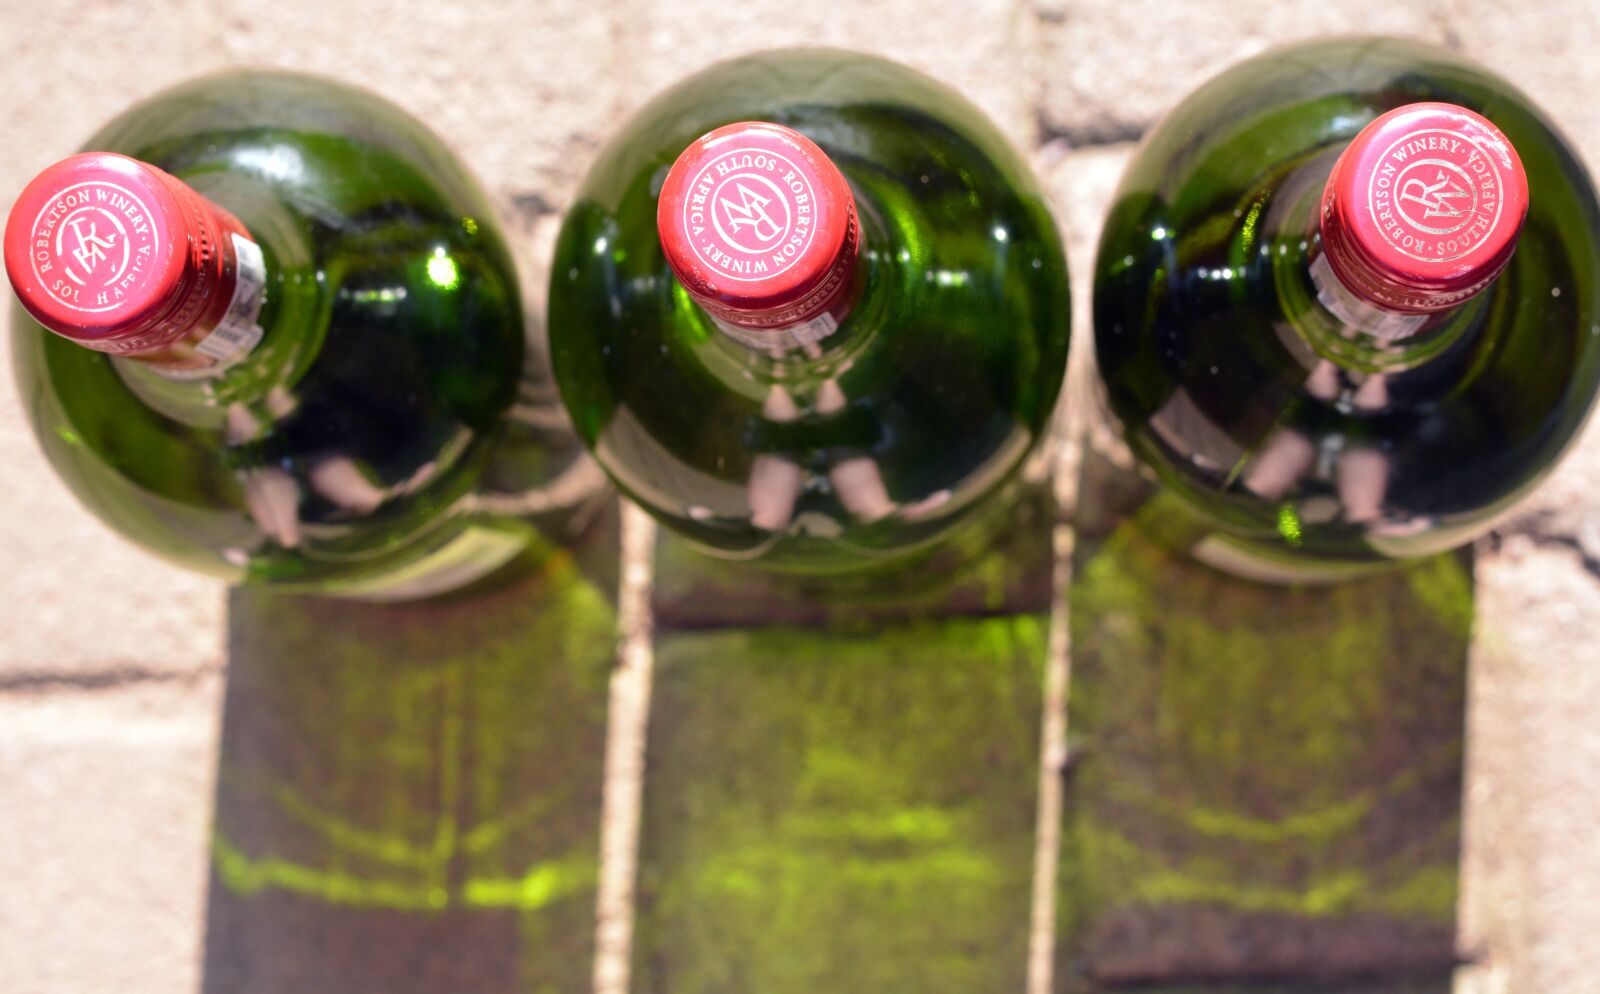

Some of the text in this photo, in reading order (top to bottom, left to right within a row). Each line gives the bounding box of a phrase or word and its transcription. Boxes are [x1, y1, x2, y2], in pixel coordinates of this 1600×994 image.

[1391, 136, 1462, 163] WINERY
[36, 188, 150, 274] ROBERTSON WINERY
[691, 155, 777, 237] SOUTH AFRICA
[702, 170, 811, 274] ROBERTSON WINERY
[1376, 162, 1426, 254] ROBERTSON
[1437, 150, 1496, 255] SOUTH AFRICA
